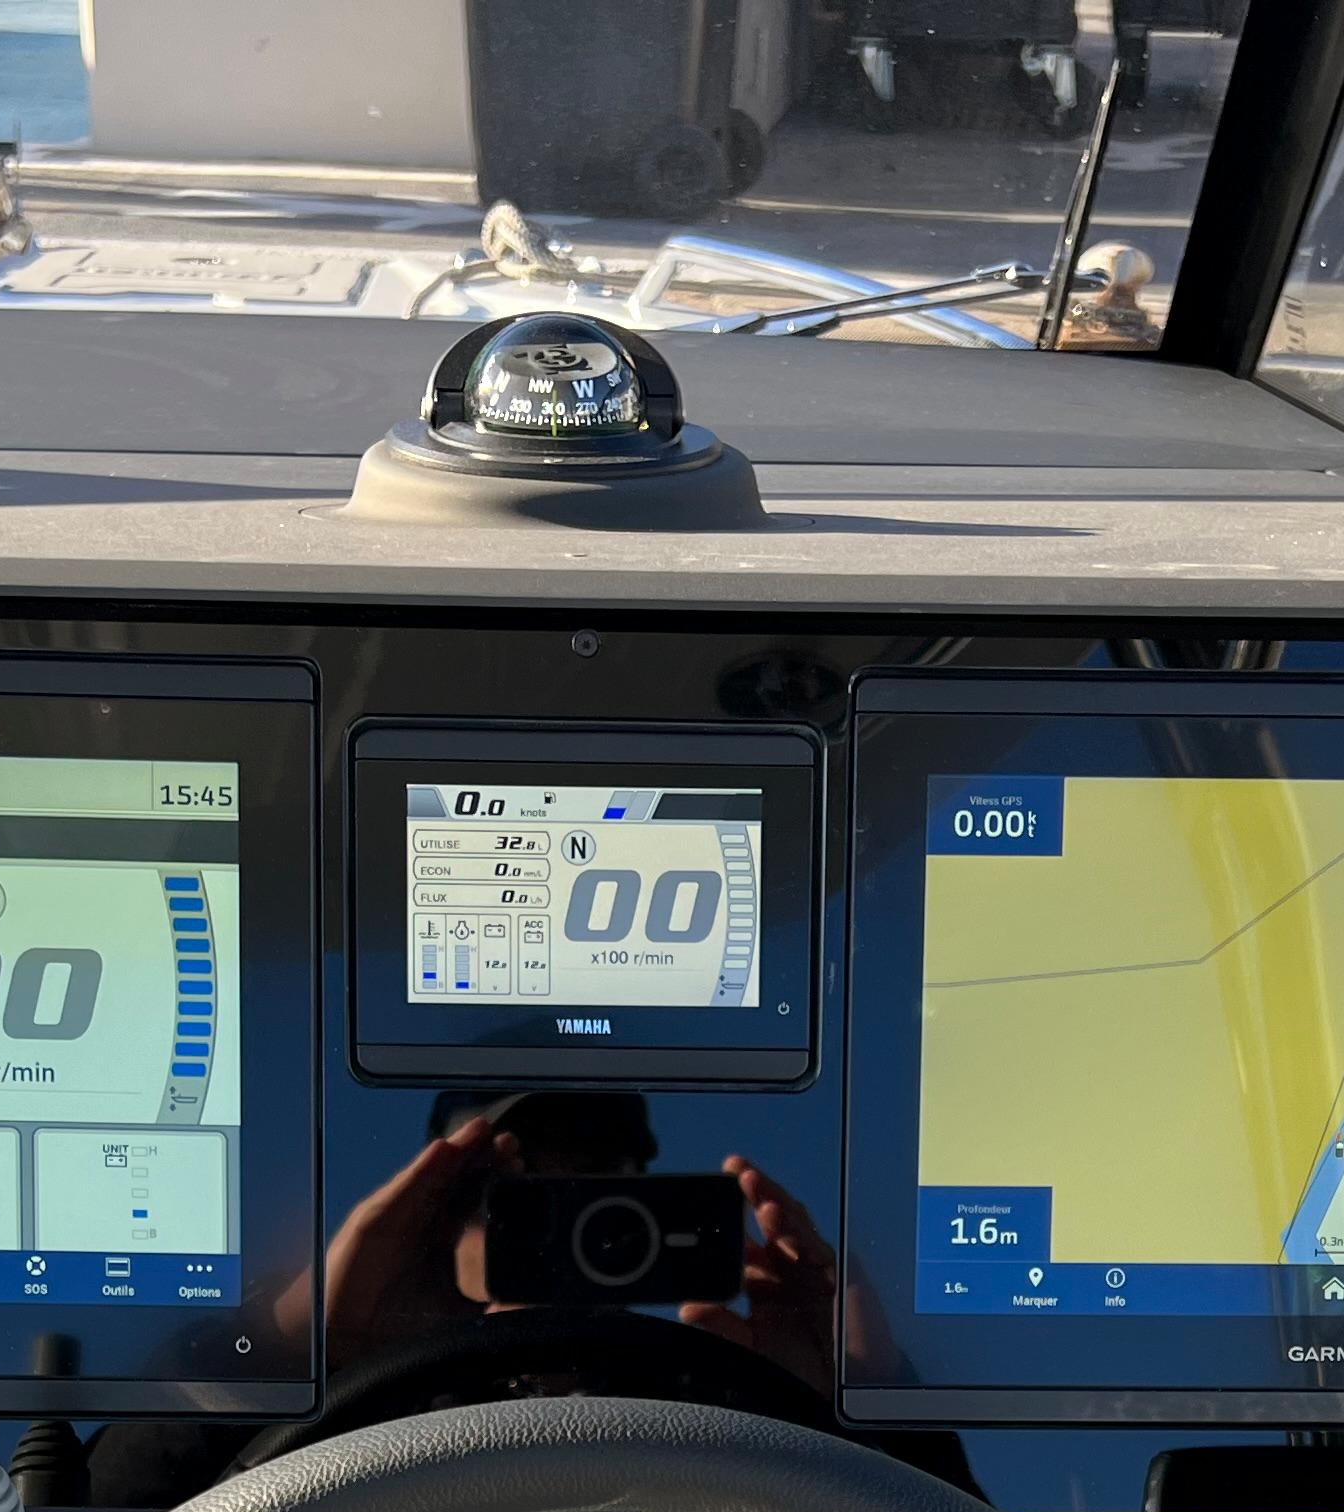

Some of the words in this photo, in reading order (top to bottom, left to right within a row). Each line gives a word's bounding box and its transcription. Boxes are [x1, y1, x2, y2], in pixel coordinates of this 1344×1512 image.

[528, 378, 553, 393] NW
[572, 380, 594, 398] W
[510, 398, 532, 413] 330
[576, 402, 597, 415] 270
[159, 785, 233, 806] 15:45
[1001, 796, 1023, 806] GPS
[455, 791, 505, 816] 0.0
[520, 808, 547, 818] knots
[954, 810, 1025, 838] 0.00
[420, 839, 461, 849] UTILISE
[494, 836, 536, 850] 32.8
[571, 836, 586, 860] N
[420, 866, 451, 876] ECON
[494, 863, 522, 877] 0.0
[420, 893, 448, 903] FLUX
[501, 890, 528, 904] 0.0
[564, 869, 723, 943] 00
[524, 920, 544, 929] ACC
[591, 951, 629, 965] x100
[633, 951, 674, 965] r/min
[556, 1018, 612, 1035] YAMAHA
[102, 1144, 129, 1155] UNIT
[148, 1146, 157, 1157] H
[957, 1204, 1011, 1215] Profondeur
[950, 1218, 1018, 1245] 1.6m
[24, 1283, 48, 1295] SOS
[102, 1284, 135, 1297] Outils
[178, 1285, 221, 1300] Options
[1012, 1295, 1058, 1309] Marquer
[1105, 1295, 1126, 1307] Info
